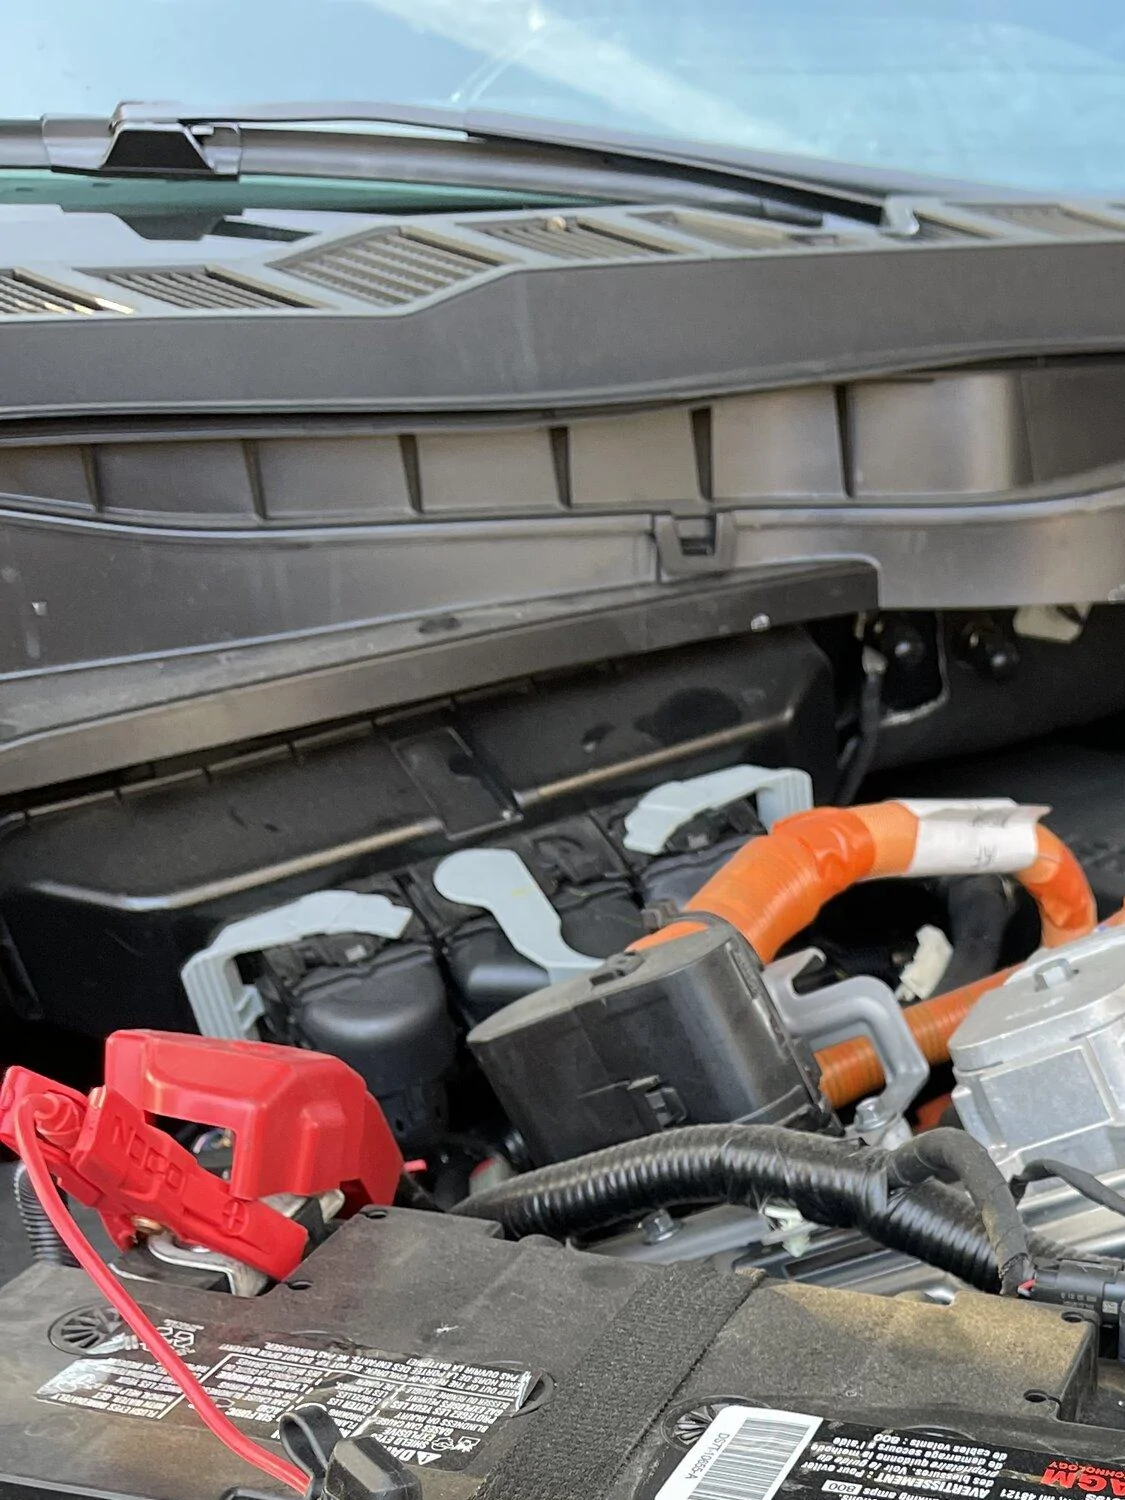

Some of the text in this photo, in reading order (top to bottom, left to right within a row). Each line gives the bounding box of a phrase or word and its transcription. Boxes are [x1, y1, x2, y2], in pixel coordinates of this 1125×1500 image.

[421, 1425, 454, 1436] GASES
[440, 1419, 489, 1433] BLINDNESS
[381, 1427, 436, 1442] EXPLOSIVE
[877, 1443, 922, 1456] secours
[909, 1440, 950, 1451] volants
[953, 1446, 991, 1456] cables
[862, 1451, 874, 1459] le
[993, 1452, 1007, 1461] de
[816, 1454, 994, 1487] des blessures. Voir le guide du
[988, 1460, 1003, 1470] de
[837, 1466, 865, 1478] Pour
[829, 1482, 856, 1493] 800
[863, 1487, 896, 1500] amps
